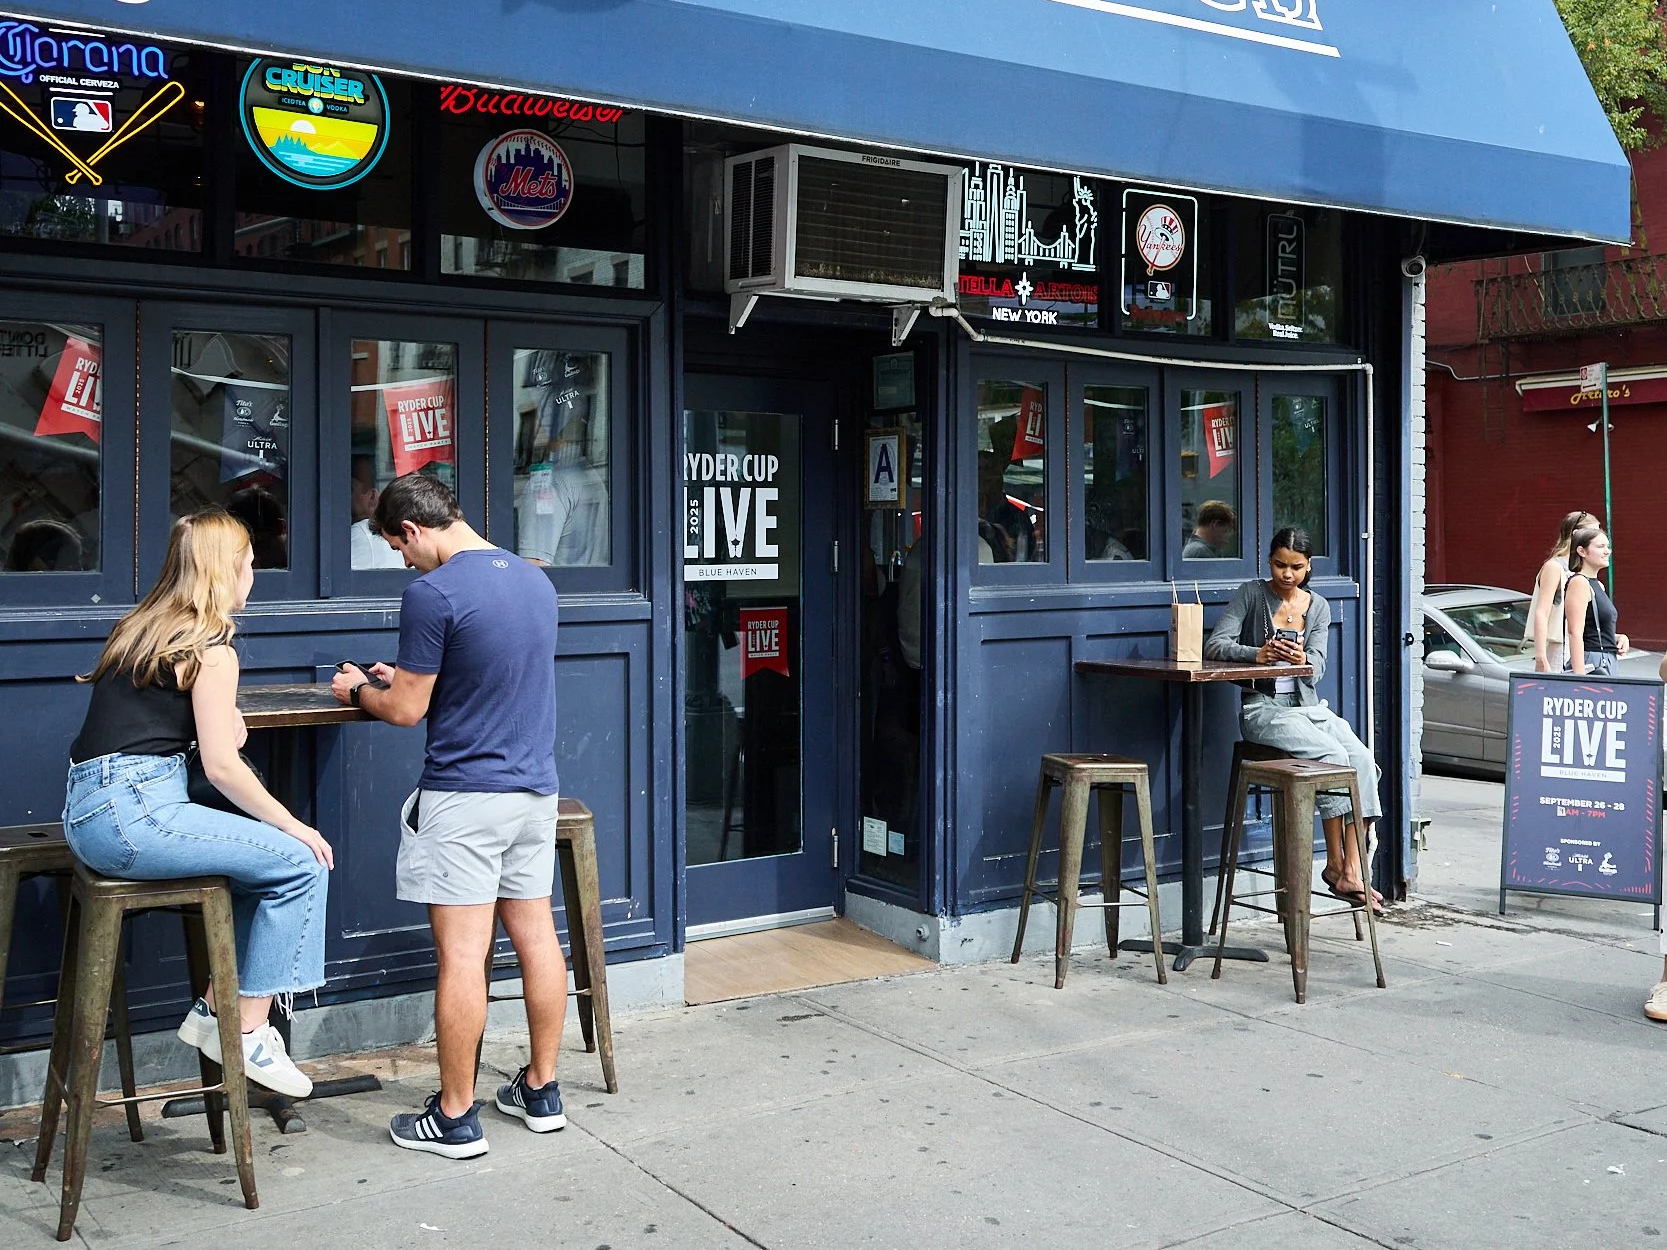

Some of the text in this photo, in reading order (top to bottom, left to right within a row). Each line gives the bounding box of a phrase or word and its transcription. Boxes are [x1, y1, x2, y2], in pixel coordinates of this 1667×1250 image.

[0, 21, 169, 83] Corona
[39, 74, 120, 89] OFFICIAL CERVEZA
[265, 66, 365, 104] CRUISER
[326, 104, 348, 113] VODKA
[862, 155, 901, 167] FRIGIDAIRE
[499, 166, 557, 199] Mets
[1140, 224, 1184, 251] Yankees
[958, 275, 1099, 304] TELLA ARTOIS
[992, 307, 1058, 325] NEW YORK
[398, 395, 445, 413] RYDER CUP
[555, 390, 580, 405] ULTRA
[400, 408, 450, 443] LIVE
[1211, 417, 1230, 428] RYDER
[247, 440, 278, 450] ULTRA
[1212, 426, 1234, 451] LIV
[742, 454, 779, 482] CUP
[873, 443, 895, 484] A
[684, 486, 779, 559] LIVE
[690, 499, 699, 535] 2025
[699, 567, 758, 577] BLUE HAVEN
[748, 620, 779, 630] RYDER CUP
[748, 629, 780, 652] LIVE
[1543, 696, 1628, 720] RYDER CUP
[1541, 717, 1627, 769] LIVE
[1553, 725, 1561, 749] 2025
[1559, 769, 1607, 779] BLUE HAVEN
[1540, 796, 1593, 809] SEPTEMBER
[1594, 801, 1606, 810] 26
[1613, 802, 1625, 811] 28
[1587, 811, 1606, 819] 7PM
[1560, 838, 1592, 846] SPONSORED
[1568, 856, 1594, 865] ULTRA
